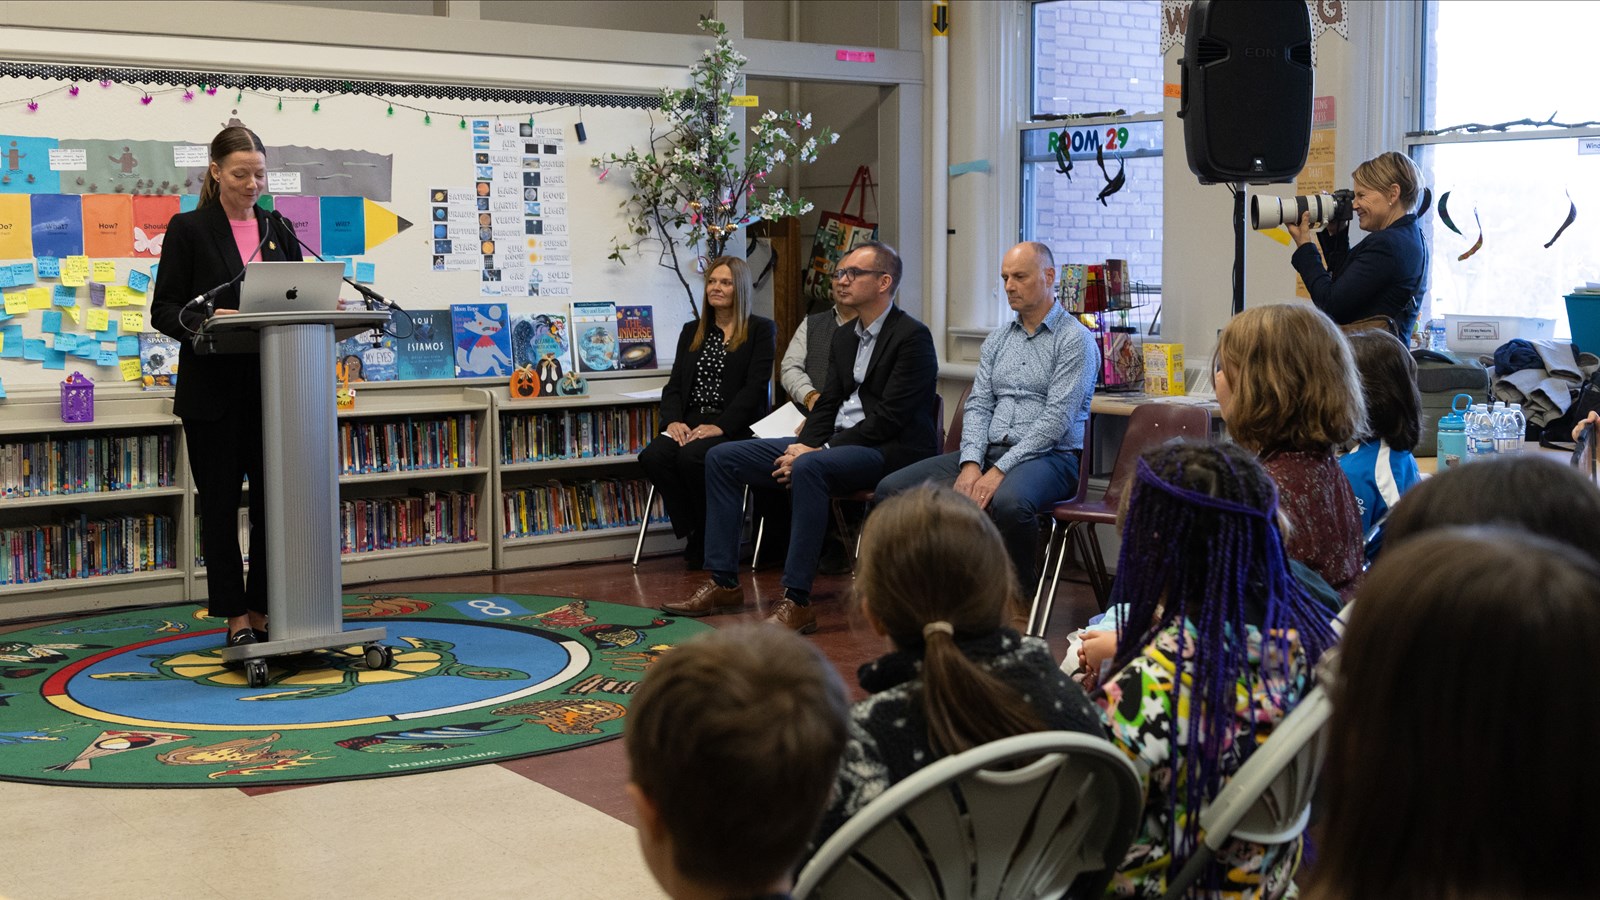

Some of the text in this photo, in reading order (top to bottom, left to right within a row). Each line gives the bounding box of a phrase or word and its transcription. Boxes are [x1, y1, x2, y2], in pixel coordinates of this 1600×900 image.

[1245, 48, 1277, 58] EON
[494, 124, 515, 133] LAND
[535, 128, 562, 136] JUPITER
[1105, 127, 1129, 150] 29
[502, 140, 516, 148] AIR
[540, 160, 565, 168] CRATER
[503, 171, 518, 179] DAY
[543, 175, 565, 184] DARK
[497, 186, 518, 195] MARS
[448, 193, 475, 201] SATURN
[542, 191, 566, 200] MOON
[493, 202, 519, 210] EARTH
[448, 210, 476, 218] URANUS
[543, 206, 567, 215] LIGHT
[495, 216, 520, 225] VENUS
[543, 224, 567, 232] NIGHT
[454, 244, 478, 252] STARS
[543, 240, 568, 248] SUNSET
[507, 245, 523, 254] SUN
[509, 273, 525, 281] GAS
[547, 271, 570, 279] SOLID
[500, 285, 525, 293] LIQUID
[540, 287, 570, 295] ROCKET
[624, 319, 642, 329] THE
[617, 327, 653, 339] UNIVERSE
[407, 341, 444, 352] ESTAMOS
[365, 351, 392, 363] MY EYES
[388, 750, 501, 769] WINTERGREEN
